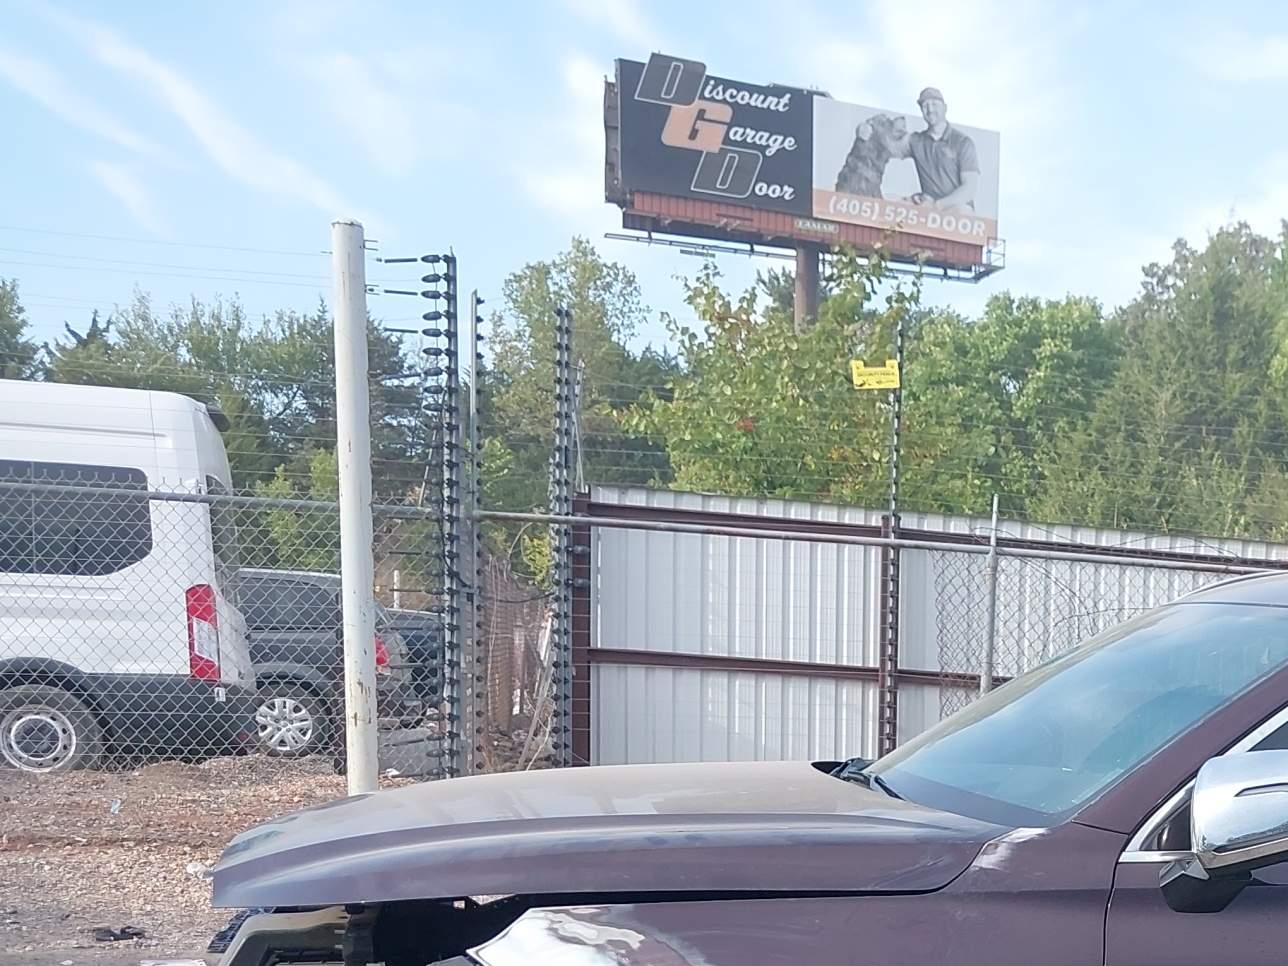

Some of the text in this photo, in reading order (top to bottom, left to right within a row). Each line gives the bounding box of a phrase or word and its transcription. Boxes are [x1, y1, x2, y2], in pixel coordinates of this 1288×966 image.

[634, 52, 791, 112] Discount
[661, 99, 797, 156] Garage
[691, 144, 795, 199] Door
[829, 195, 985, 237] (405) 525-DOOR
